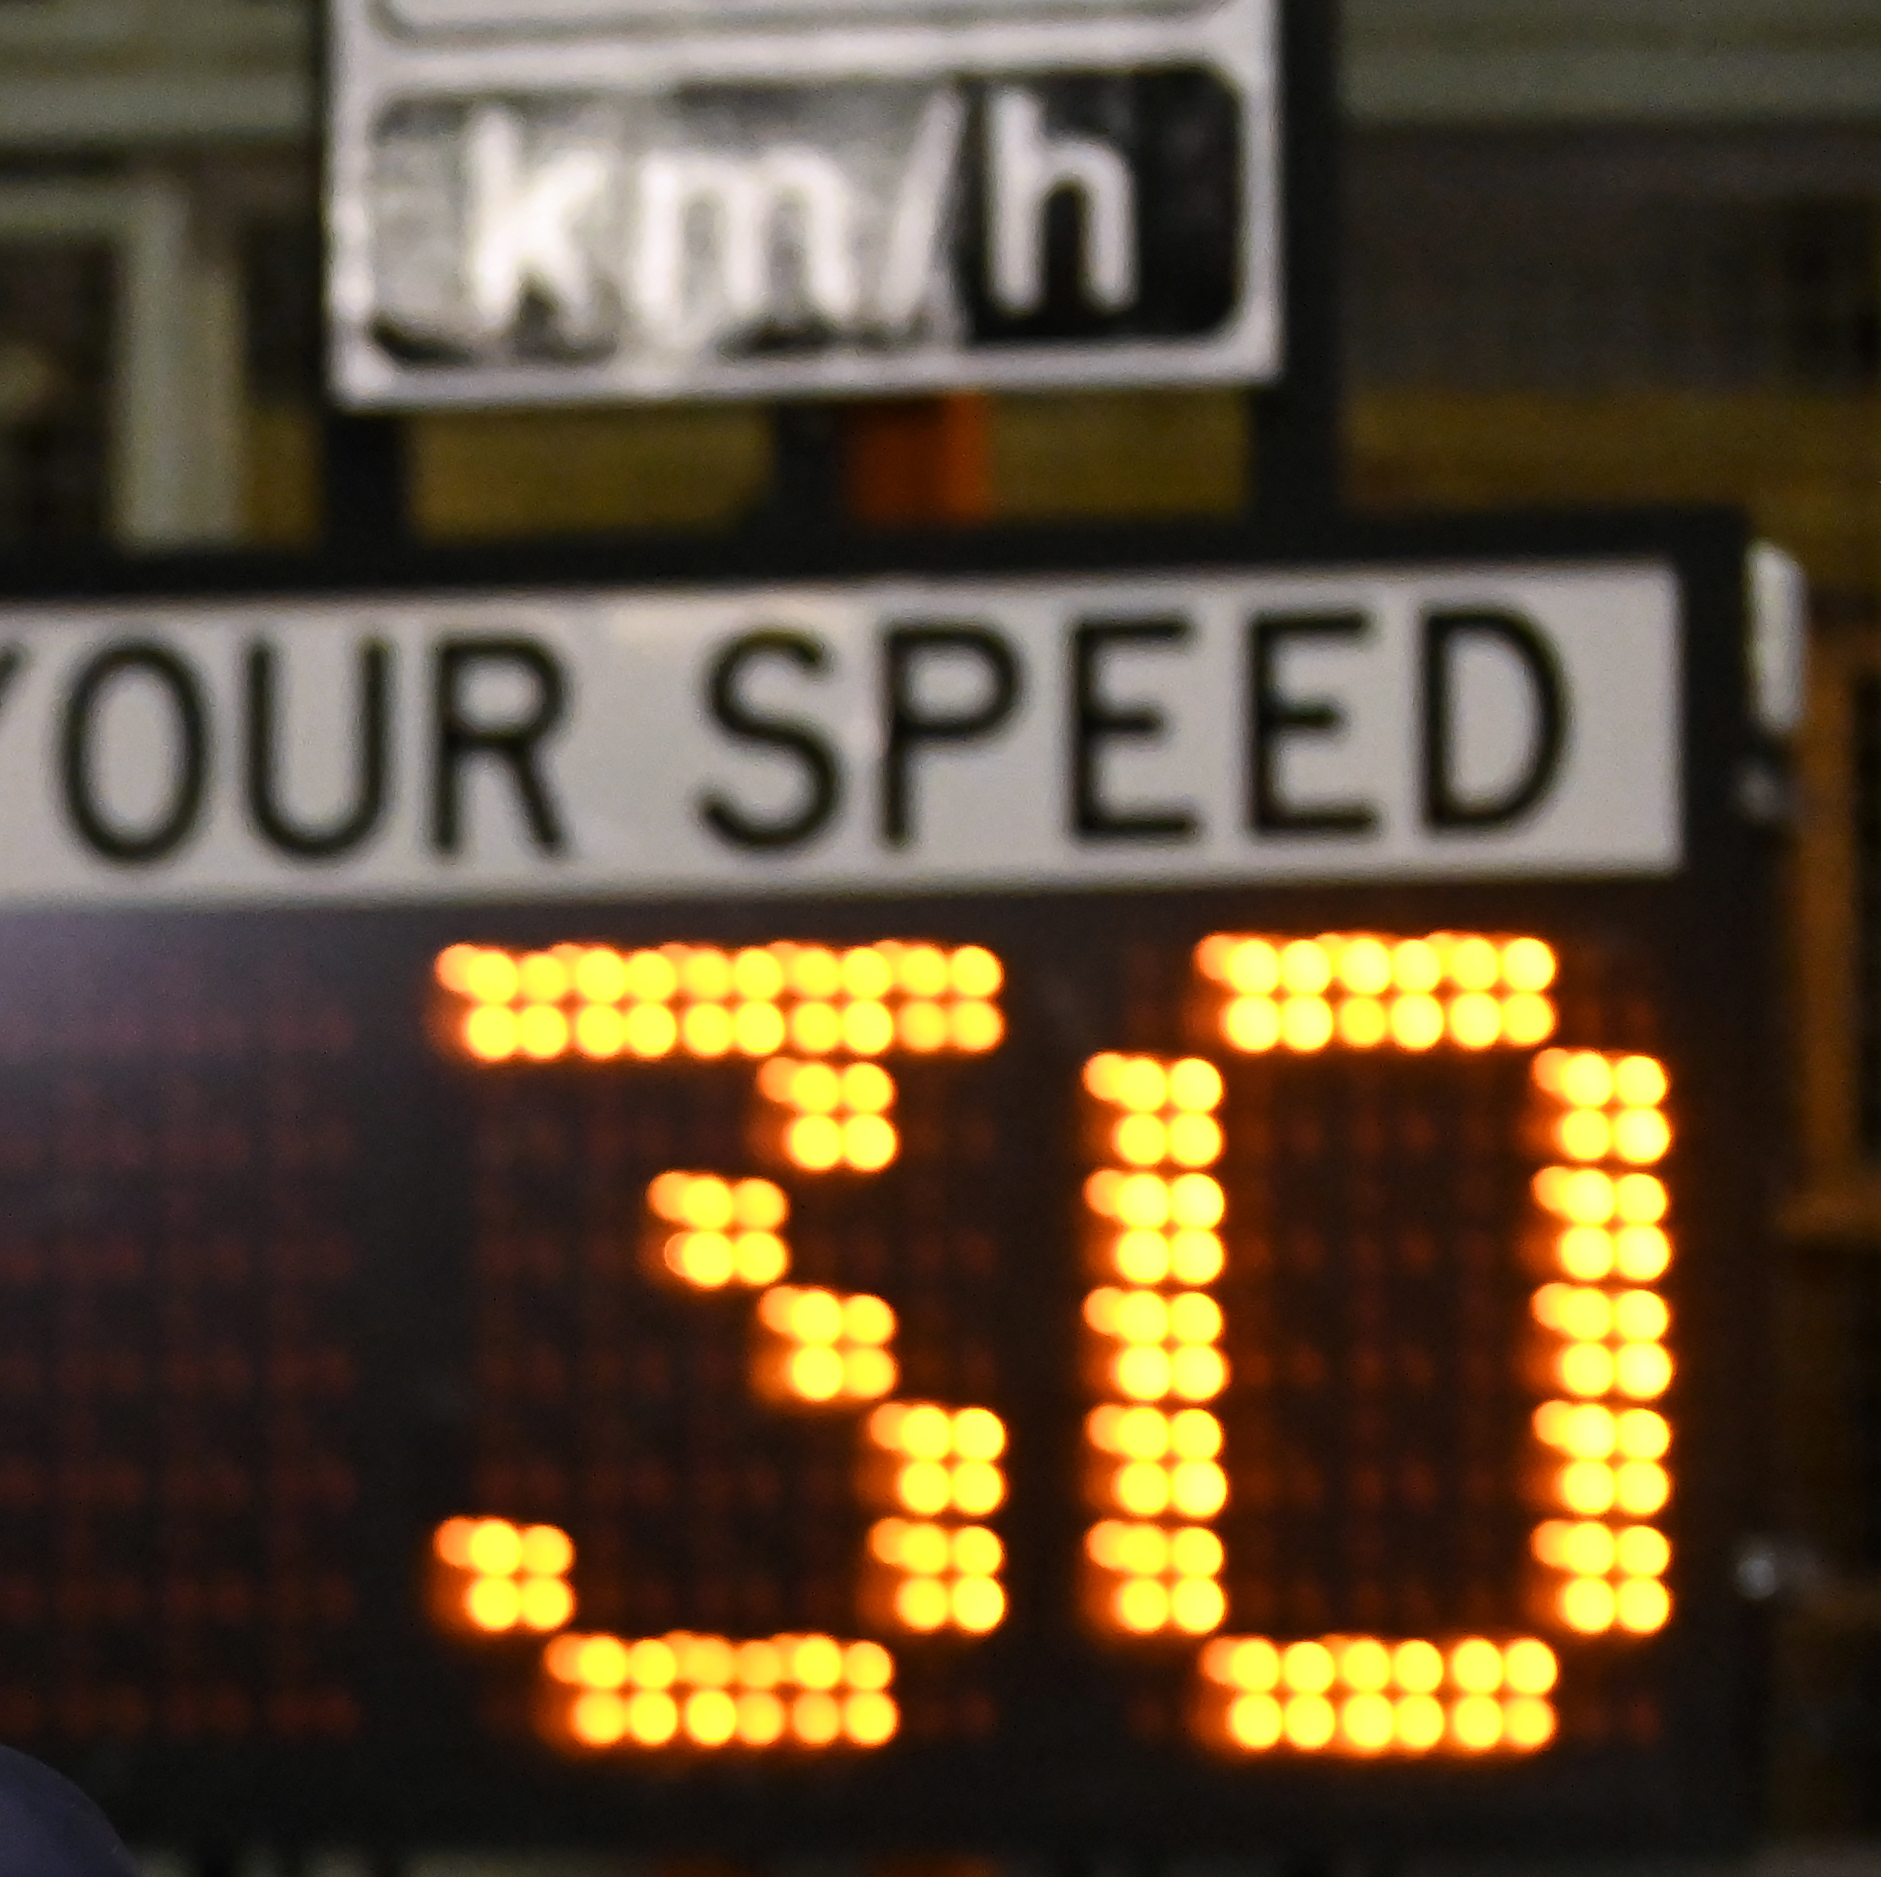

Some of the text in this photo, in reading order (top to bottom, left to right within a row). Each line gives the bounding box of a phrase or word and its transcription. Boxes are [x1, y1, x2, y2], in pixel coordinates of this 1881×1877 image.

[465, 85, 1134, 338] km/h
[697, 605, 1573, 856] SPEED
[434, 930, 1674, 1757] 30
